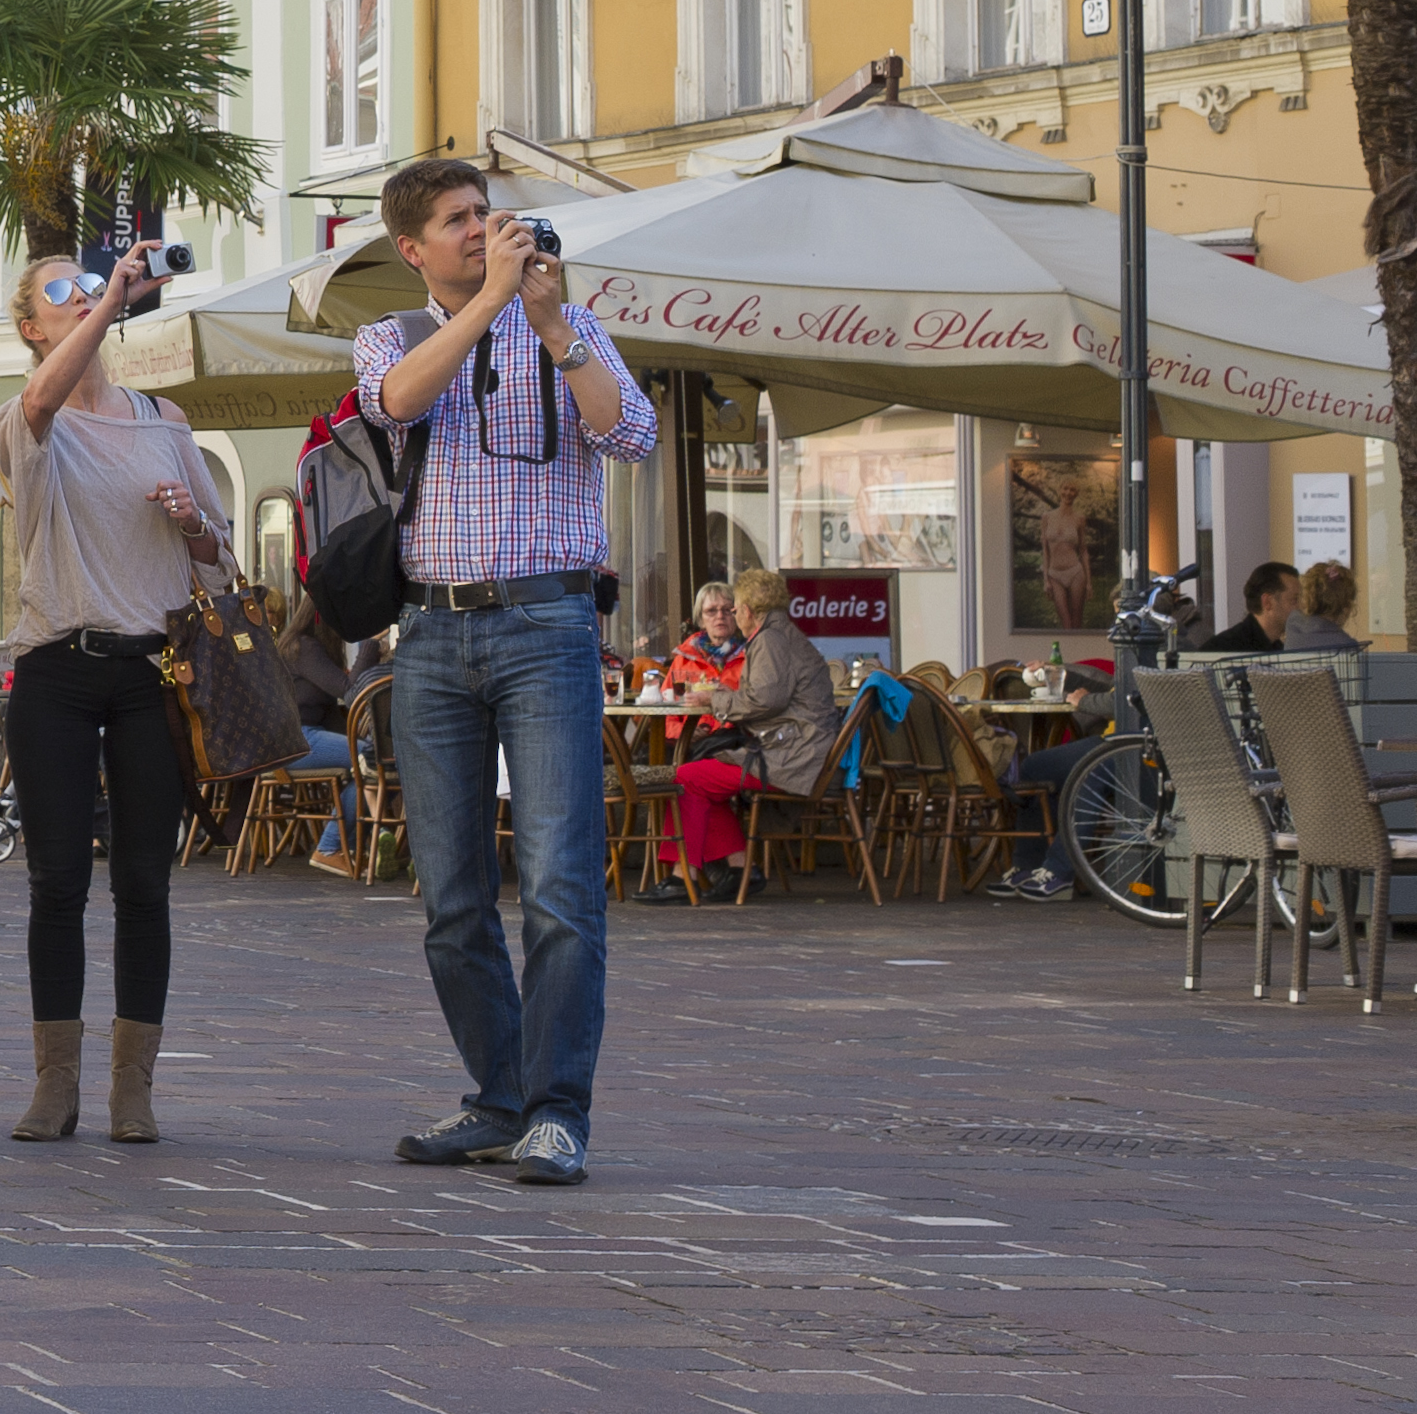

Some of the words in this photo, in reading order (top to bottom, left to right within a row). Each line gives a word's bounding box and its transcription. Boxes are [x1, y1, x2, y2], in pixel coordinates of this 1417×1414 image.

[1087, 1, 1104, 23] 25
[585, 276, 652, 324] Eis
[663, 288, 762, 344] Café
[772, 303, 903, 349] Alter
[904, 308, 1050, 352] Platz
[1072, 323, 1211, 389] Geleria
[1222, 365, 1395, 426] Caffetteria
[788, 595, 869, 619] Galerie
[871, 600, 887, 622] 3
